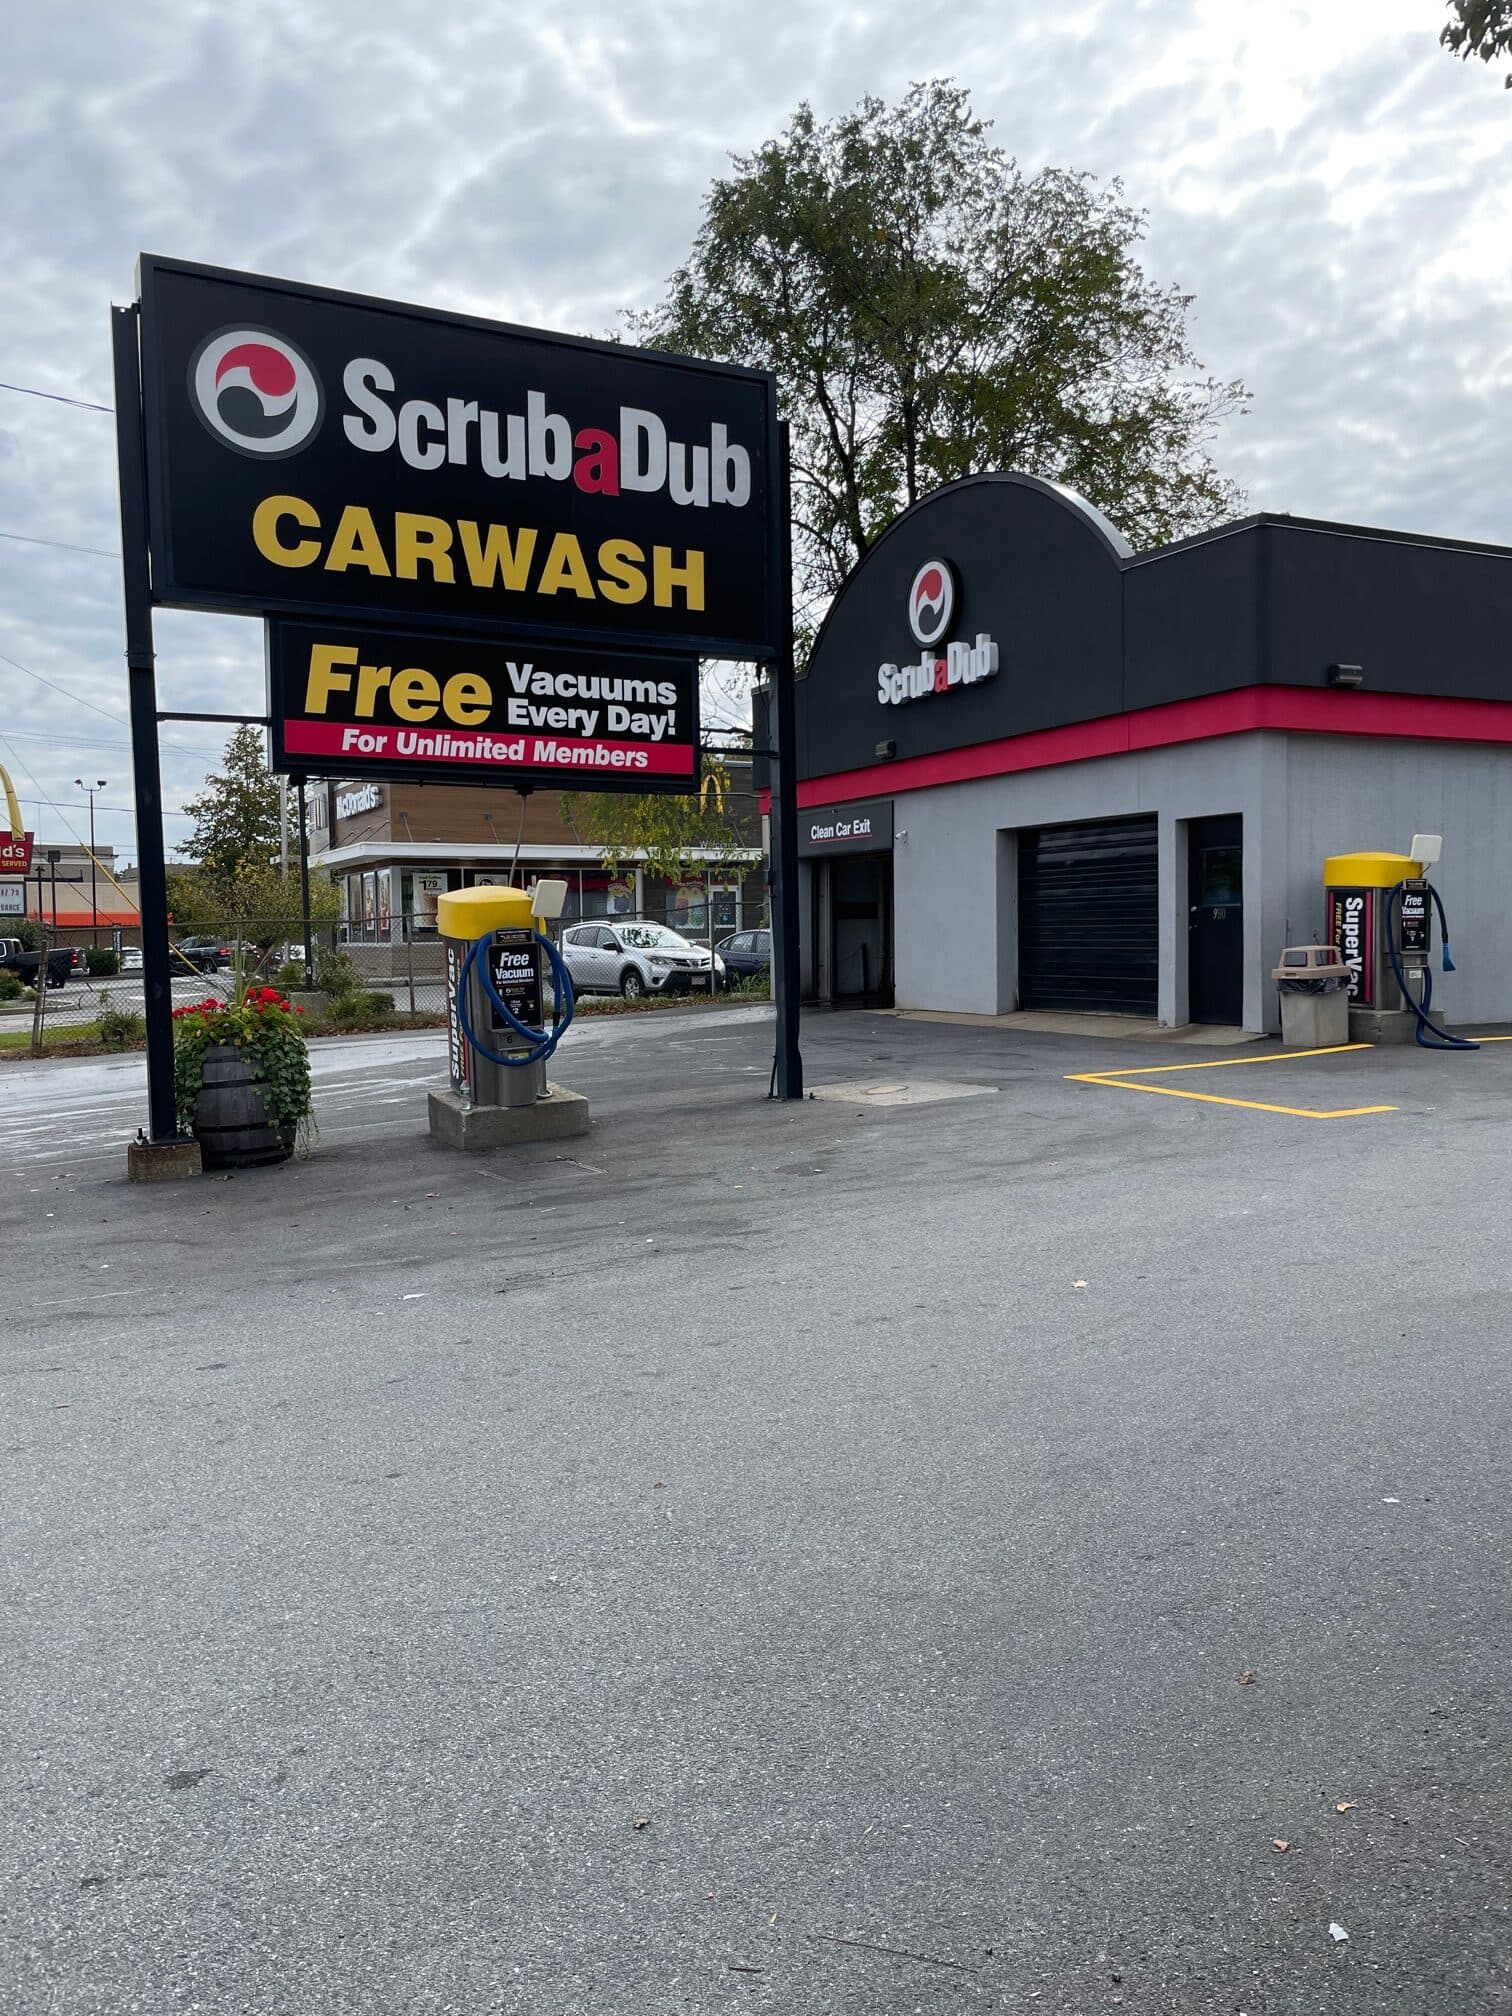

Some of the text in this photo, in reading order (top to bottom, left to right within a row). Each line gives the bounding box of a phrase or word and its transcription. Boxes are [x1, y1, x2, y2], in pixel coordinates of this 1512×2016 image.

[342, 357, 751, 508] ScrubaDub
[251, 494, 706, 612] CARWASH
[304, 643, 493, 727] Free
[505, 661, 678, 706] Vacuums
[878, 632, 999, 705] ScrubaDub
[507, 697, 676, 742] Every Day!
[341, 728, 649, 768] For Unlimited Members
[0, 844, 25, 858] d's
[810, 818, 871, 840] Clean Car Exit
[1404, 894, 1423, 906] Free
[500, 952, 530, 967] Free
[1342, 897, 1364, 997] SuperVac
[495, 968, 534, 980] Vacuum
[448, 948, 460, 1080] SuperVac
[507, 1035, 513, 1044] 6
